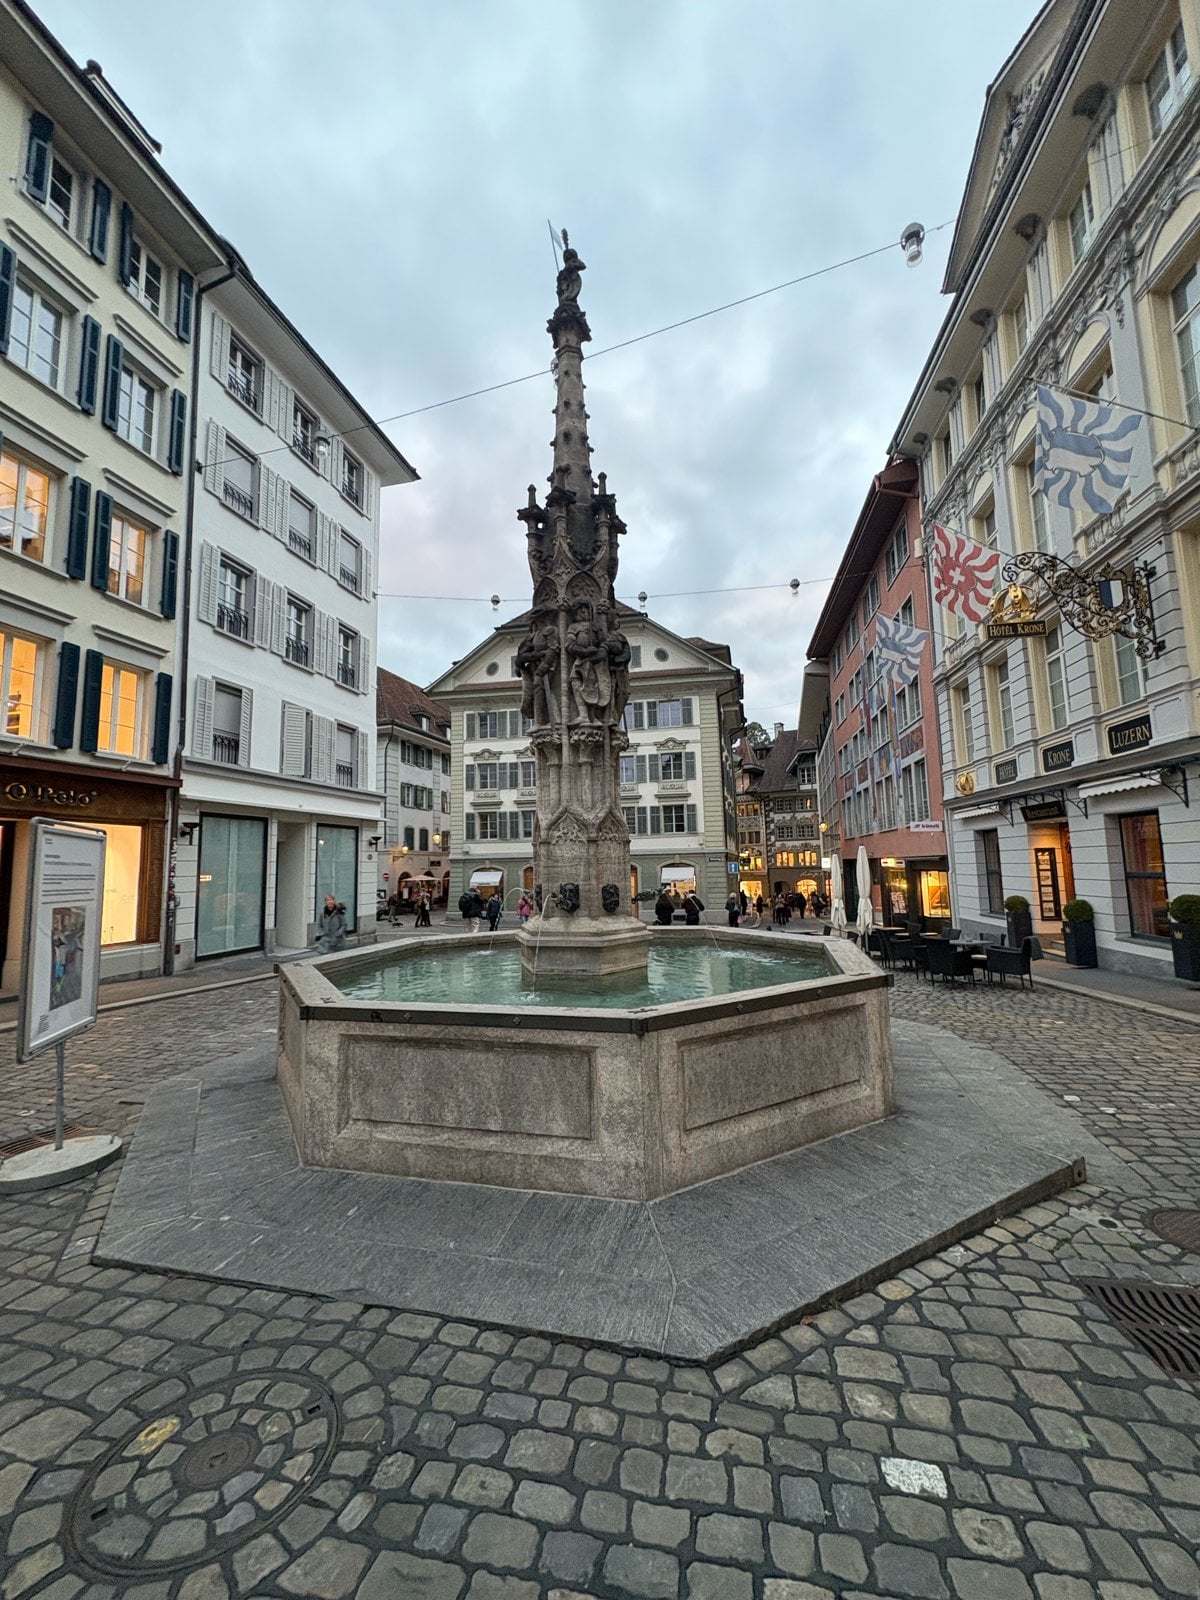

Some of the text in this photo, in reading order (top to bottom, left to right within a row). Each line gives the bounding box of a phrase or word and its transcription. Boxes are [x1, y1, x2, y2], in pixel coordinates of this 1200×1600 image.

[1017, 623, 1045, 634] KRONE
[1047, 749, 1070, 767] KRONE
[1111, 724, 1150, 749] LUZERN
